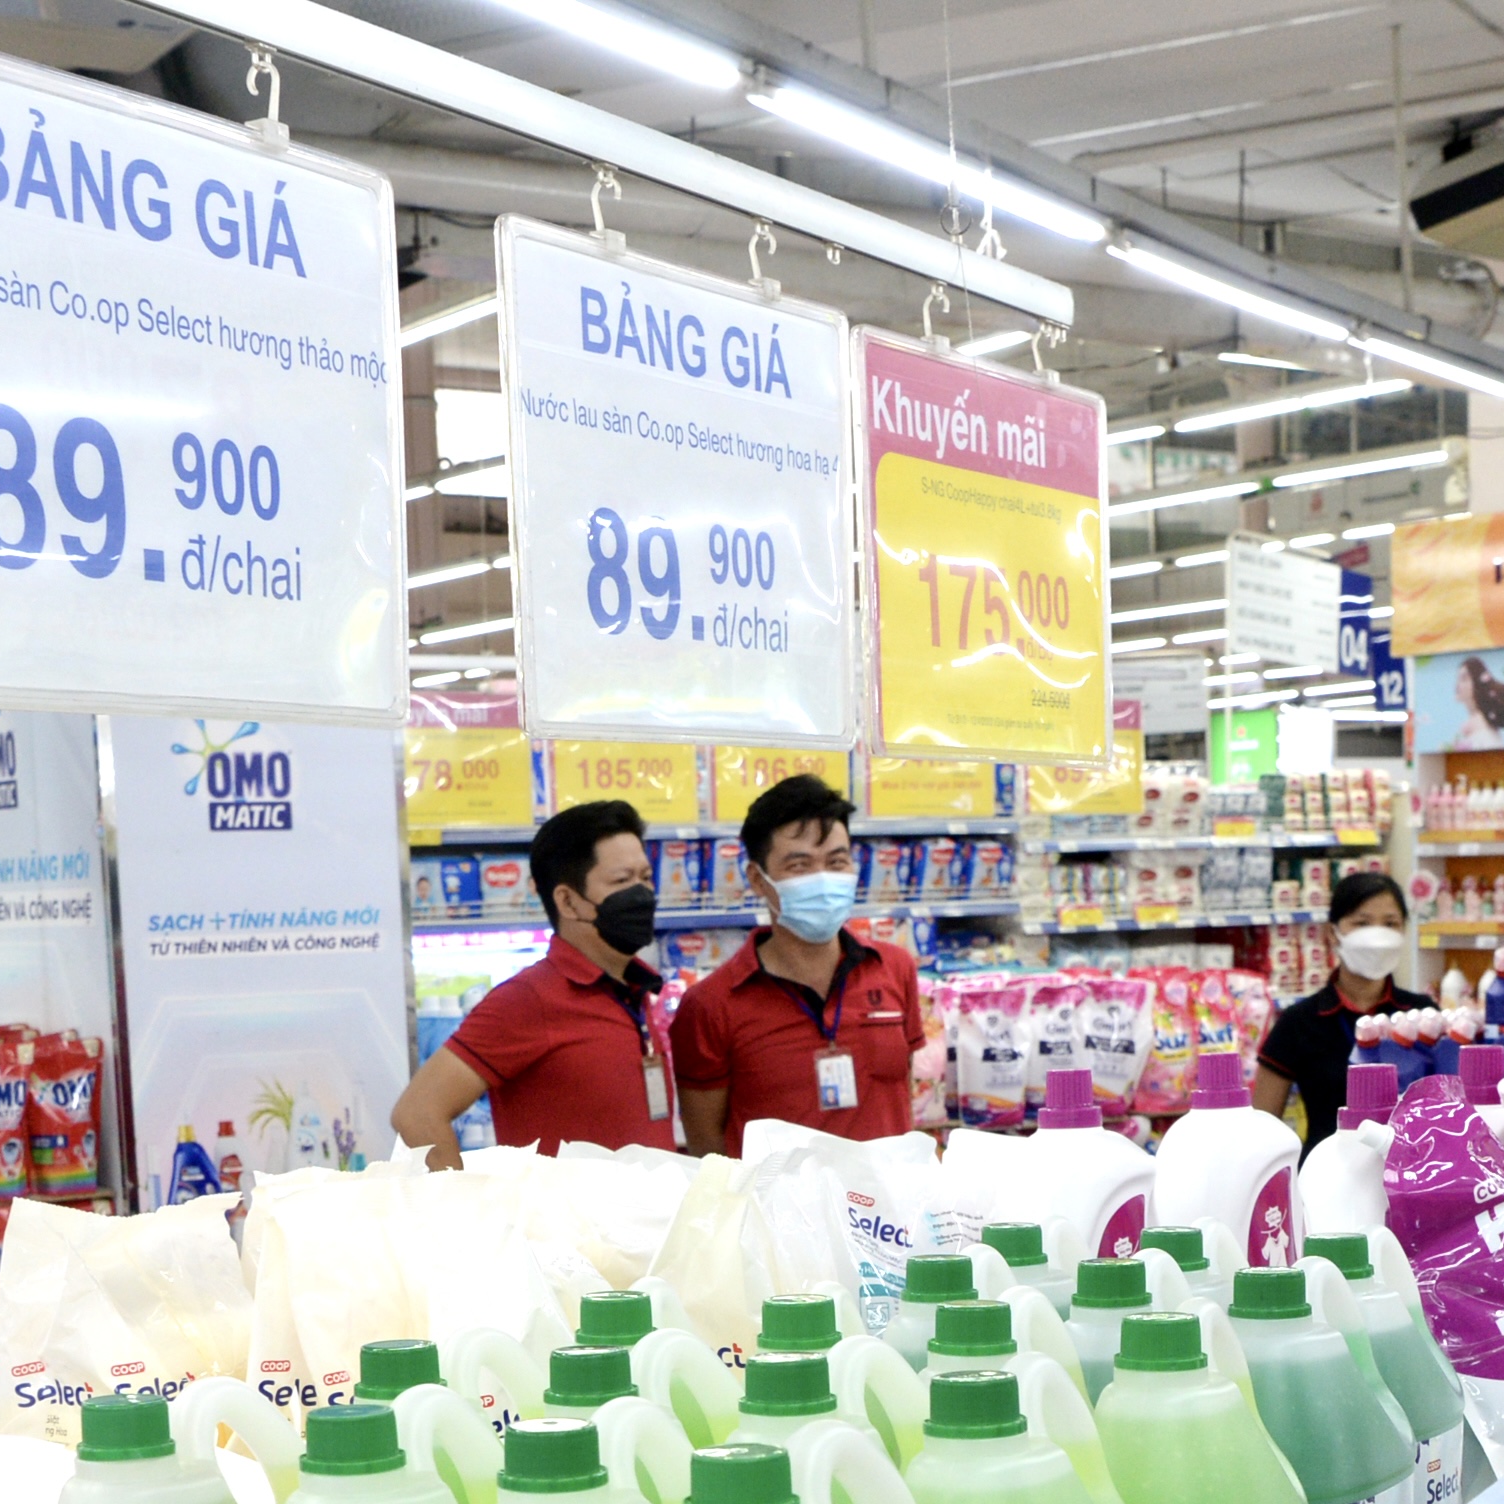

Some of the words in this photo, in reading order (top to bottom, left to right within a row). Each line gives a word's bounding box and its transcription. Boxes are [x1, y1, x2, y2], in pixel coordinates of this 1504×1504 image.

[195, 180, 308, 279] GIÁ
[49, 280, 130, 331] Co.op
[137, 298, 214, 347] Select
[218, 324, 293, 371] hương
[297, 335, 345, 375] thảo
[580, 281, 707, 378] BẢNG
[721, 323, 792, 400] GIÁ
[521, 386, 570, 423] Nước
[573, 398, 598, 429] lau
[603, 405, 632, 436] sàn
[637, 411, 684, 450] Co.op
[736, 432, 783, 473] hương
[786, 444, 812, 470] hoa
[814, 452, 830, 481] hạ
[872, 375, 989, 460] Khuyến
[997, 415, 1046, 469] mãi
[171, 431, 280, 521] 900
[181, 534, 302, 602] đ/chai
[708, 523, 776, 592] 900
[1017, 570, 1070, 630] 000
[712, 606, 789, 654] đ/chai
[1340, 626, 1369, 670] 04
[1379, 671, 1404, 705] 12
[206, 750, 291, 799] OMO
[214, 805, 286, 830] MATIC
[18, 852, 61, 885] NĂNG
[62, 847, 92, 883] MỚI
[148, 914, 204, 937] SẠCH
[281, 909, 337, 929] NĂNG
[342, 907, 381, 926] MỚI
[150, 940, 171, 956] TỪ
[174, 938, 218, 955] THIÊN
[221, 936, 268, 954] NHIÊN
[272, 935, 290, 952] VÀ
[295, 934, 337, 951] CÔNG
[339, 932, 381, 953] NGHỆ
[112, 1363, 144, 1375] COOP
[262, 1361, 290, 1371] COOP
